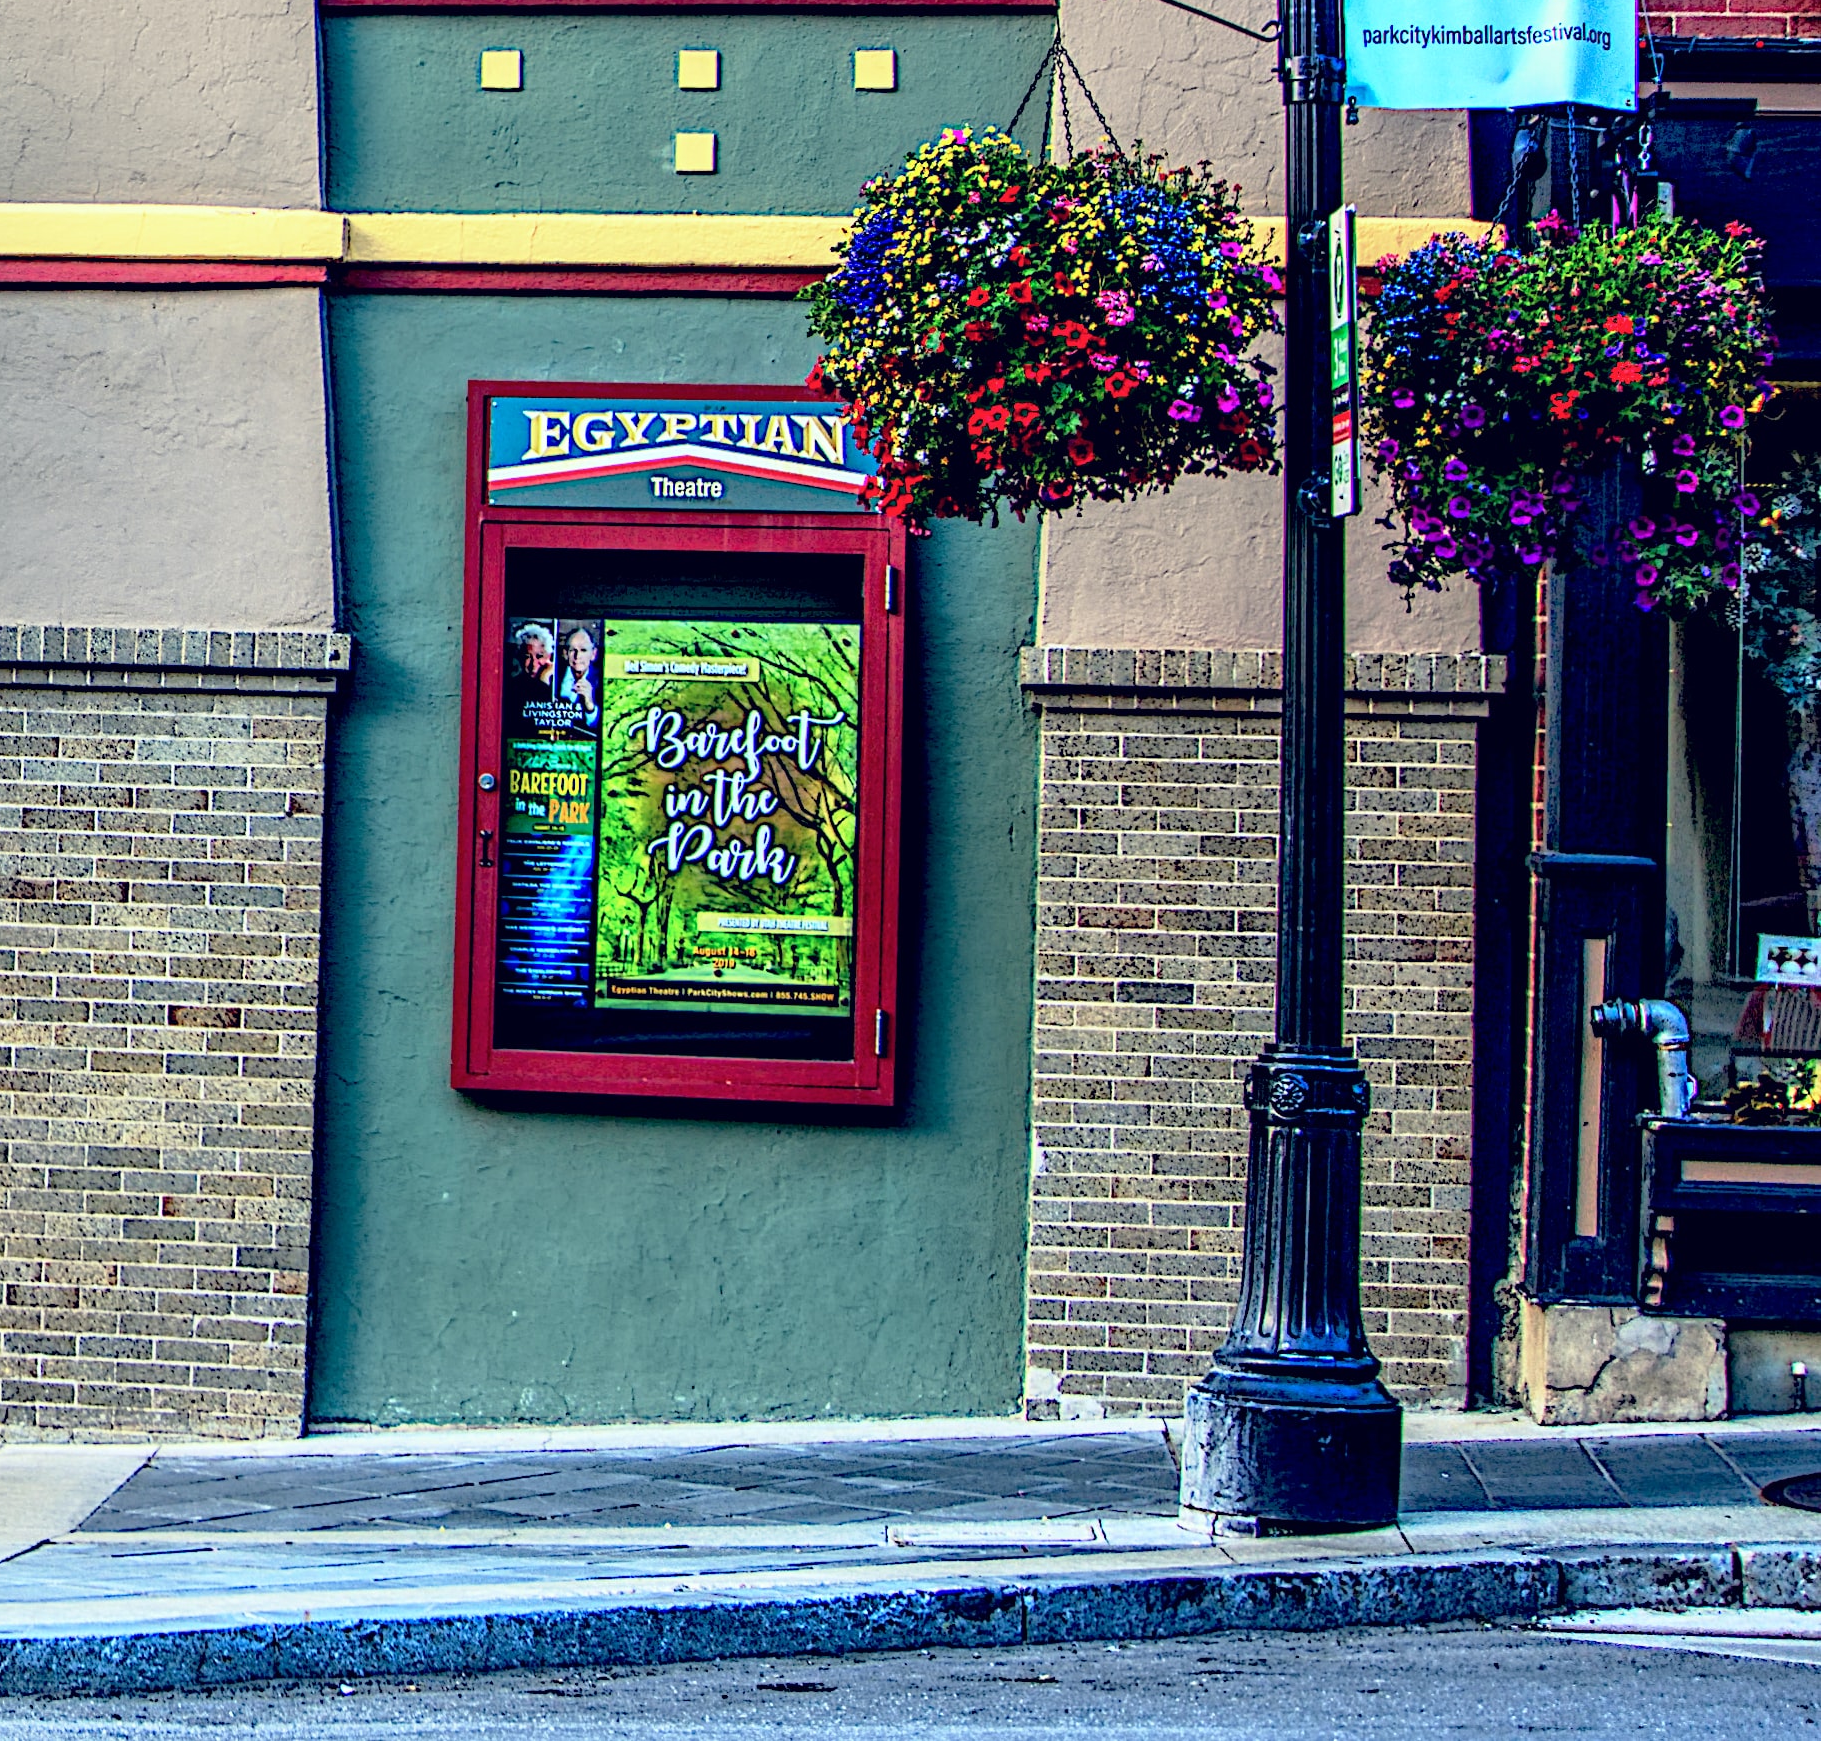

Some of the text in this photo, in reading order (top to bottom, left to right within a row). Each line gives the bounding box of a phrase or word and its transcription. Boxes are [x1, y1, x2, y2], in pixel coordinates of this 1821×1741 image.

[1362, 22, 1611, 51] parkcitykimballartsfestival.org
[521, 409, 848, 466] EGYPTIAN
[650, 475, 723, 499] Theatre
[522, 709, 583, 719] LIVINGSTON
[523, 700, 553, 710] JANIS
[534, 718, 572, 727] TAYLOR
[629, 706, 845, 781] Barefoot
[509, 769, 589, 797] BAREFOOT
[515, 797, 591, 824] in the PARK
[664, 768, 779, 828] in the
[647, 821, 796, 885] Park
[692, 946, 726, 958] August
[611, 984, 648, 996] Egyptian
[649, 986, 680, 997] Theatre
[687, 987, 769, 1000] ParkCityShows.com
